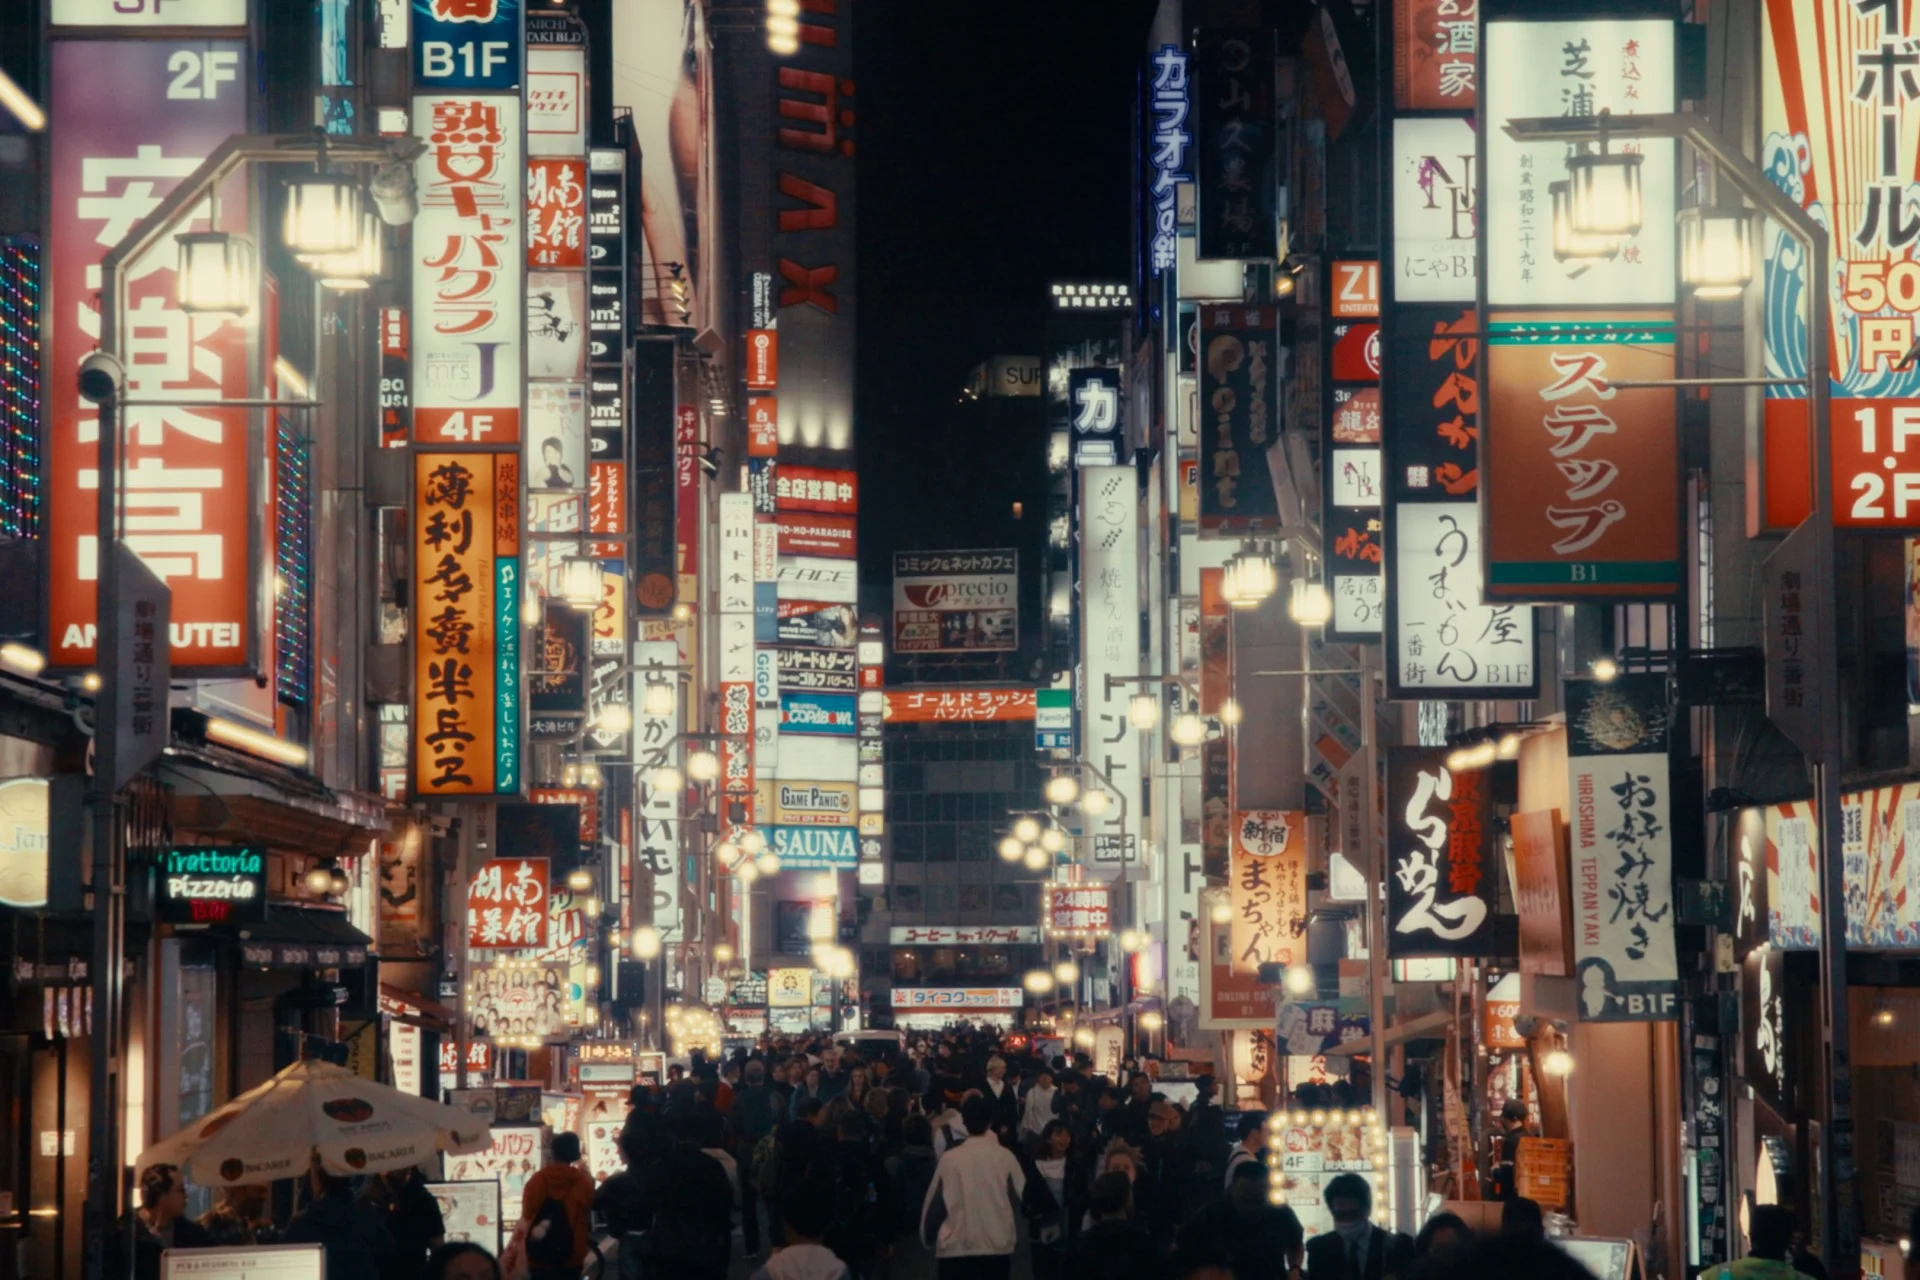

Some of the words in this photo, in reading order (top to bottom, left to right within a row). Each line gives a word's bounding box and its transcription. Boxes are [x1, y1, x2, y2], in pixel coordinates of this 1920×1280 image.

[166, 51, 239, 100] 2F
[423, 41, 509, 77] B1F
[1860, 317, 1914, 372] 円
[440, 411, 493, 441] 4F
[1539, 353, 1626, 554] ステップ
[777, 477, 852, 503] 全店営業中
[1571, 565, 1597, 580] B1
[1429, 515, 1477, 682] うまいもん
[1477, 604, 1523, 645] 屋
[757, 653, 769, 698] GiGO
[1406, 622, 1427, 684] 一番街
[1577, 773, 1594, 849] HIROSHIMA
[774, 829, 857, 857] SAUNA
[168, 876, 254, 898] Pizzeria
[1606, 772, 1669, 960] お好み焼き
[1241, 860, 1274, 965] まっちゃん
[1627, 993, 1676, 1014] B1F
